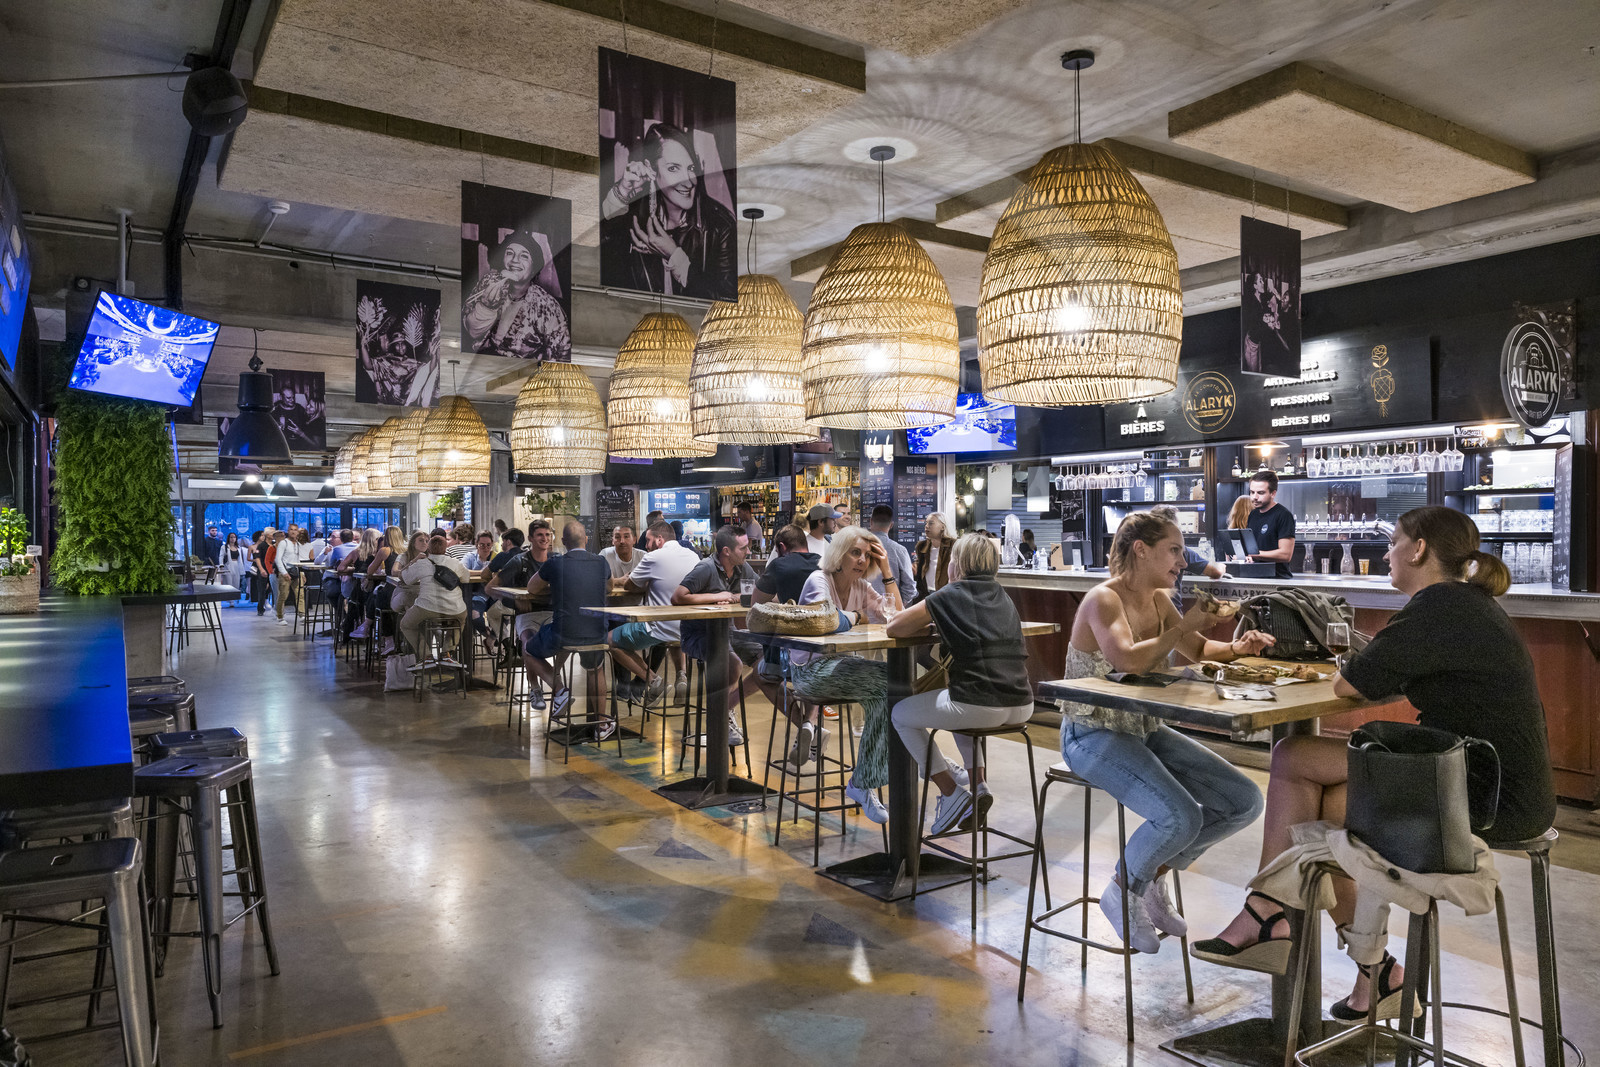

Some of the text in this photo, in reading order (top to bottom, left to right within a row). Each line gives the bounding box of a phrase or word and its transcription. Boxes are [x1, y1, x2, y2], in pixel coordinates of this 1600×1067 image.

[1511, 367, 1558, 393] ALARYK
[1186, 394, 1233, 412] ALARYK
[1271, 392, 1330, 407] PRESSIONS
[1120, 420, 1165, 435] BIÈRES
[1272, 413, 1331, 427] BIÈRES BIO
[906, 465, 926, 475] NOS BIÈRES
